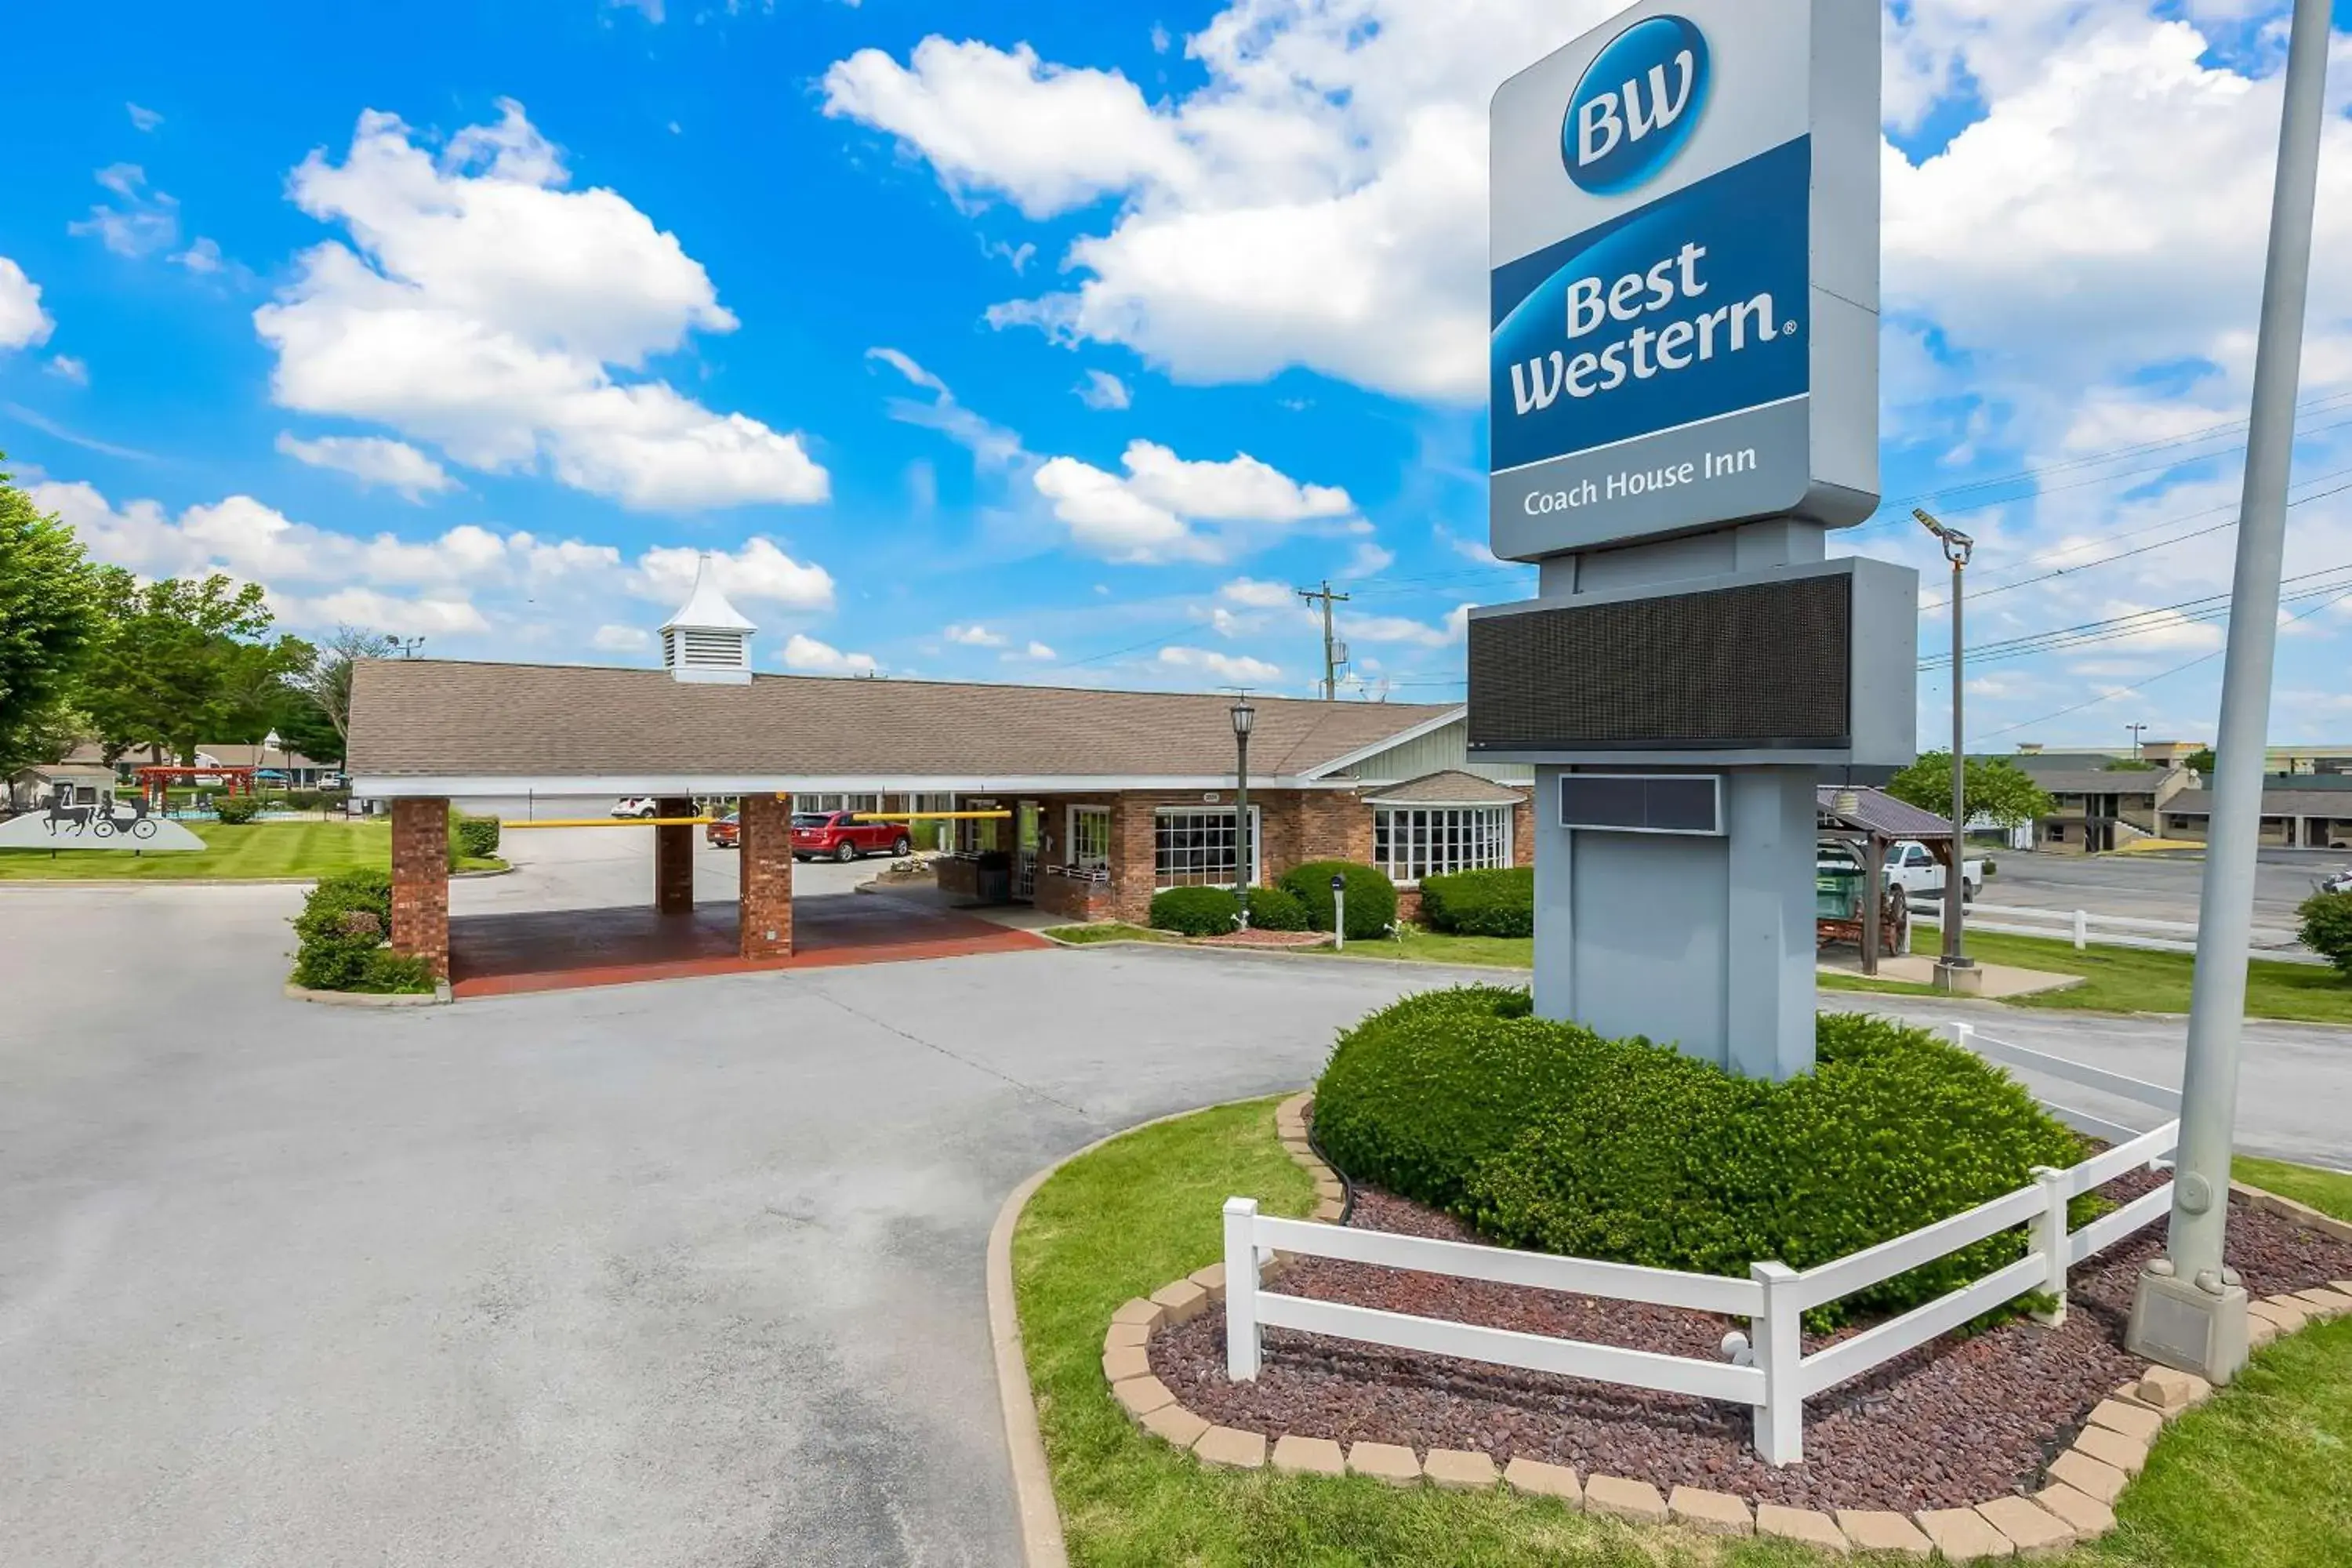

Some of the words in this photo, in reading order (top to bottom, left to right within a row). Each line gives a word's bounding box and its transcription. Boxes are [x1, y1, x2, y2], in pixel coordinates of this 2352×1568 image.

[1575, 50, 1693, 166] BW
[1566, 242, 1706, 339] Best
[1524, 479, 1598, 516] Coach
[1606, 462, 1694, 499] House
[1705, 448, 1757, 480] Inn
